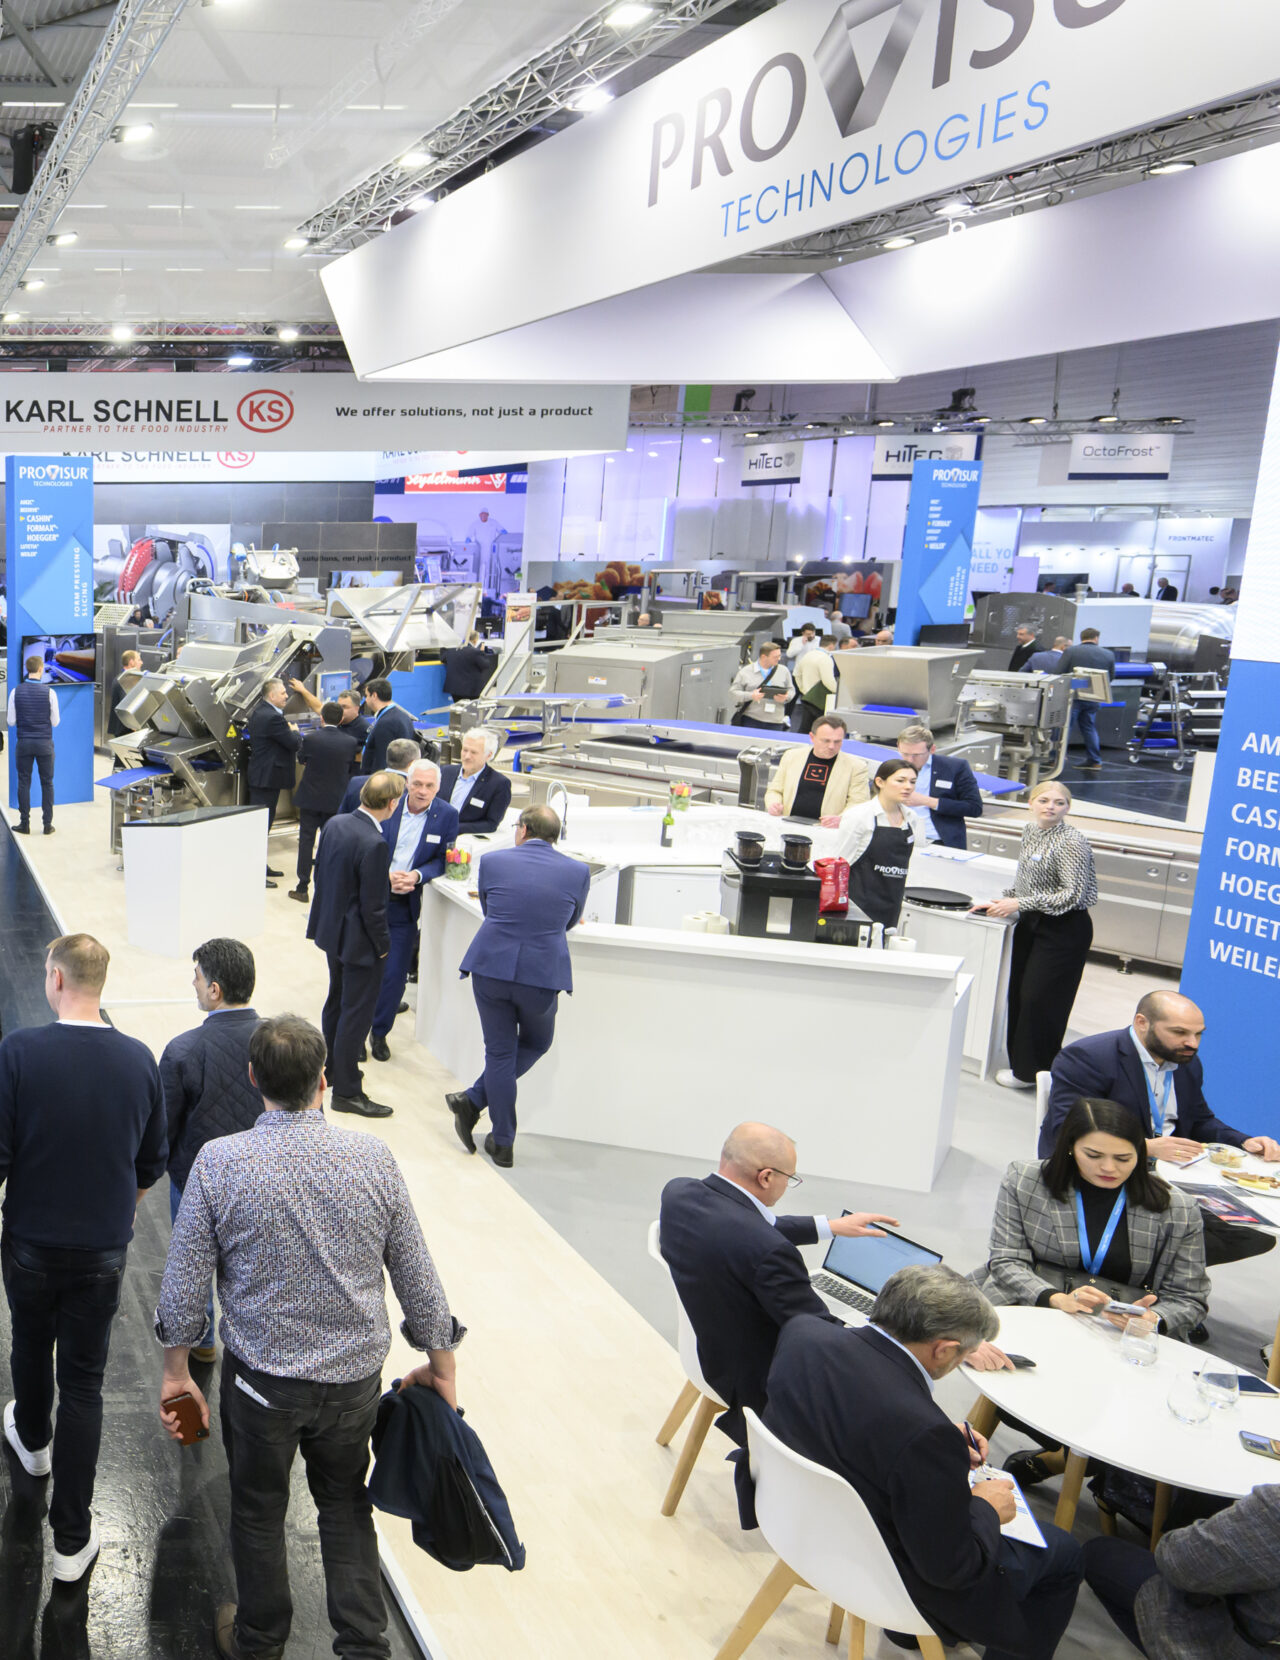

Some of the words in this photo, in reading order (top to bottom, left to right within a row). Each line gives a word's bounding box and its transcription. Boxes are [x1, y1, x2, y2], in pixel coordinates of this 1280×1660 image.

[721, 80, 1051, 238] TECHNOLOGIES
[5, 400, 84, 423] KARL
[93, 399, 229, 423] SCHNELL
[249, 400, 285, 422] KS
[335, 407, 358, 417] We
[362, 405, 395, 417] offer
[400, 406, 467, 418] solutions,
[472, 406, 495, 417] not
[497, 406, 525, 419] just
[528, 409, 537, 417] a
[540, 406, 594, 419] product
[43, 425, 92, 433] PARTNER
[98, 425, 110, 433] TO
[116, 425, 136, 433] THE
[141, 425, 170, 433] FOOD
[174, 425, 229, 433] INDUSTRY
[749, 453, 783, 470] HITEC
[19, 464, 88, 480] PROVISUR
[932, 468, 979, 482] PROVISUR
[1231, 803, 1280, 831] CAS
[1210, 939, 1280, 979] WEILE
